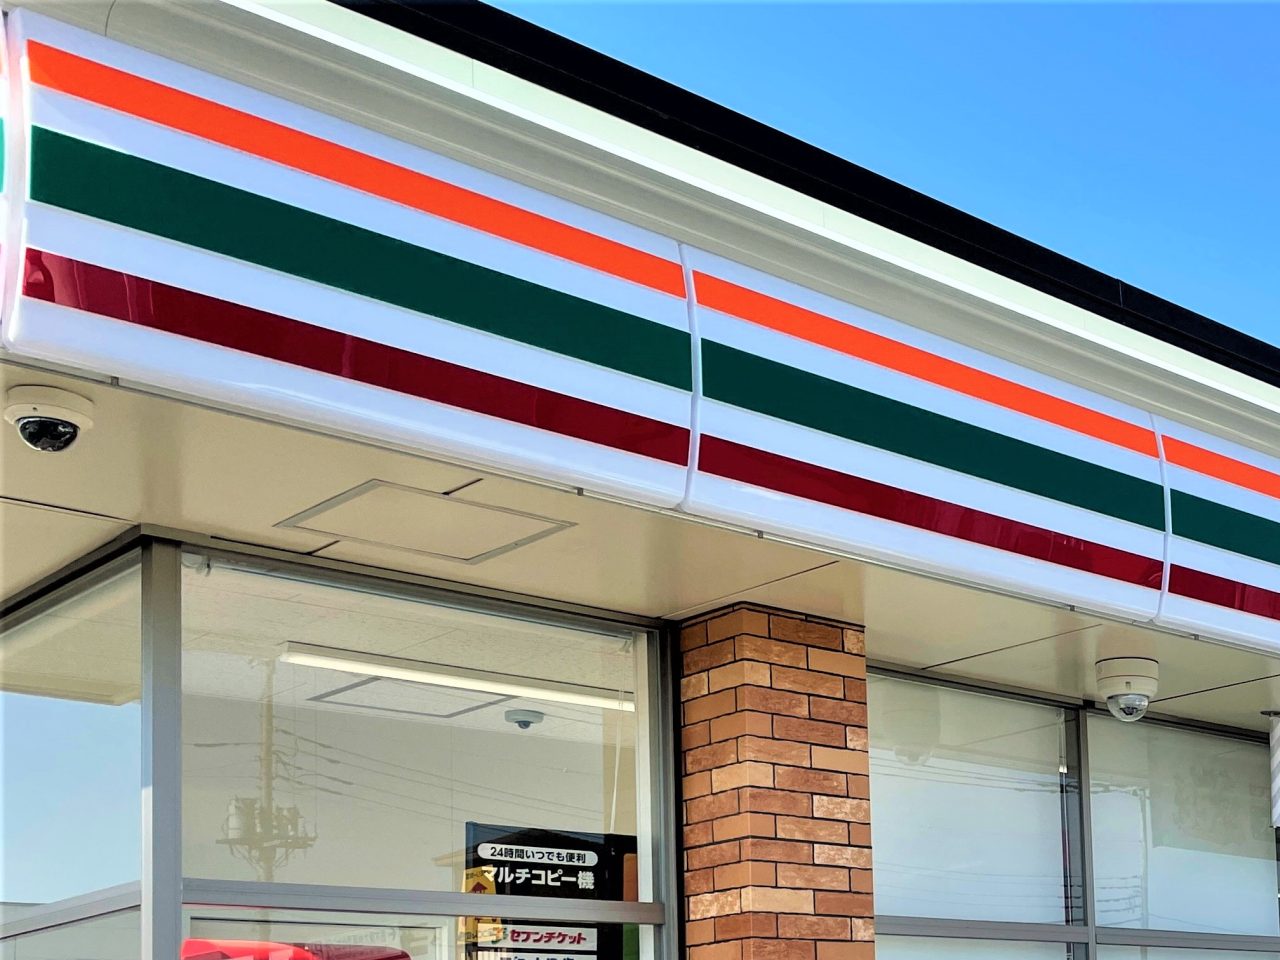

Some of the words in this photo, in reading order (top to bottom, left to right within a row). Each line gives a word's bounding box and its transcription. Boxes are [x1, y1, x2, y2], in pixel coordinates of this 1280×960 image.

[490, 846, 586, 864] 24時間いつでも便利
[481, 865, 595, 890] マルチコピー機
[510, 929, 587, 945] セブンチケット
